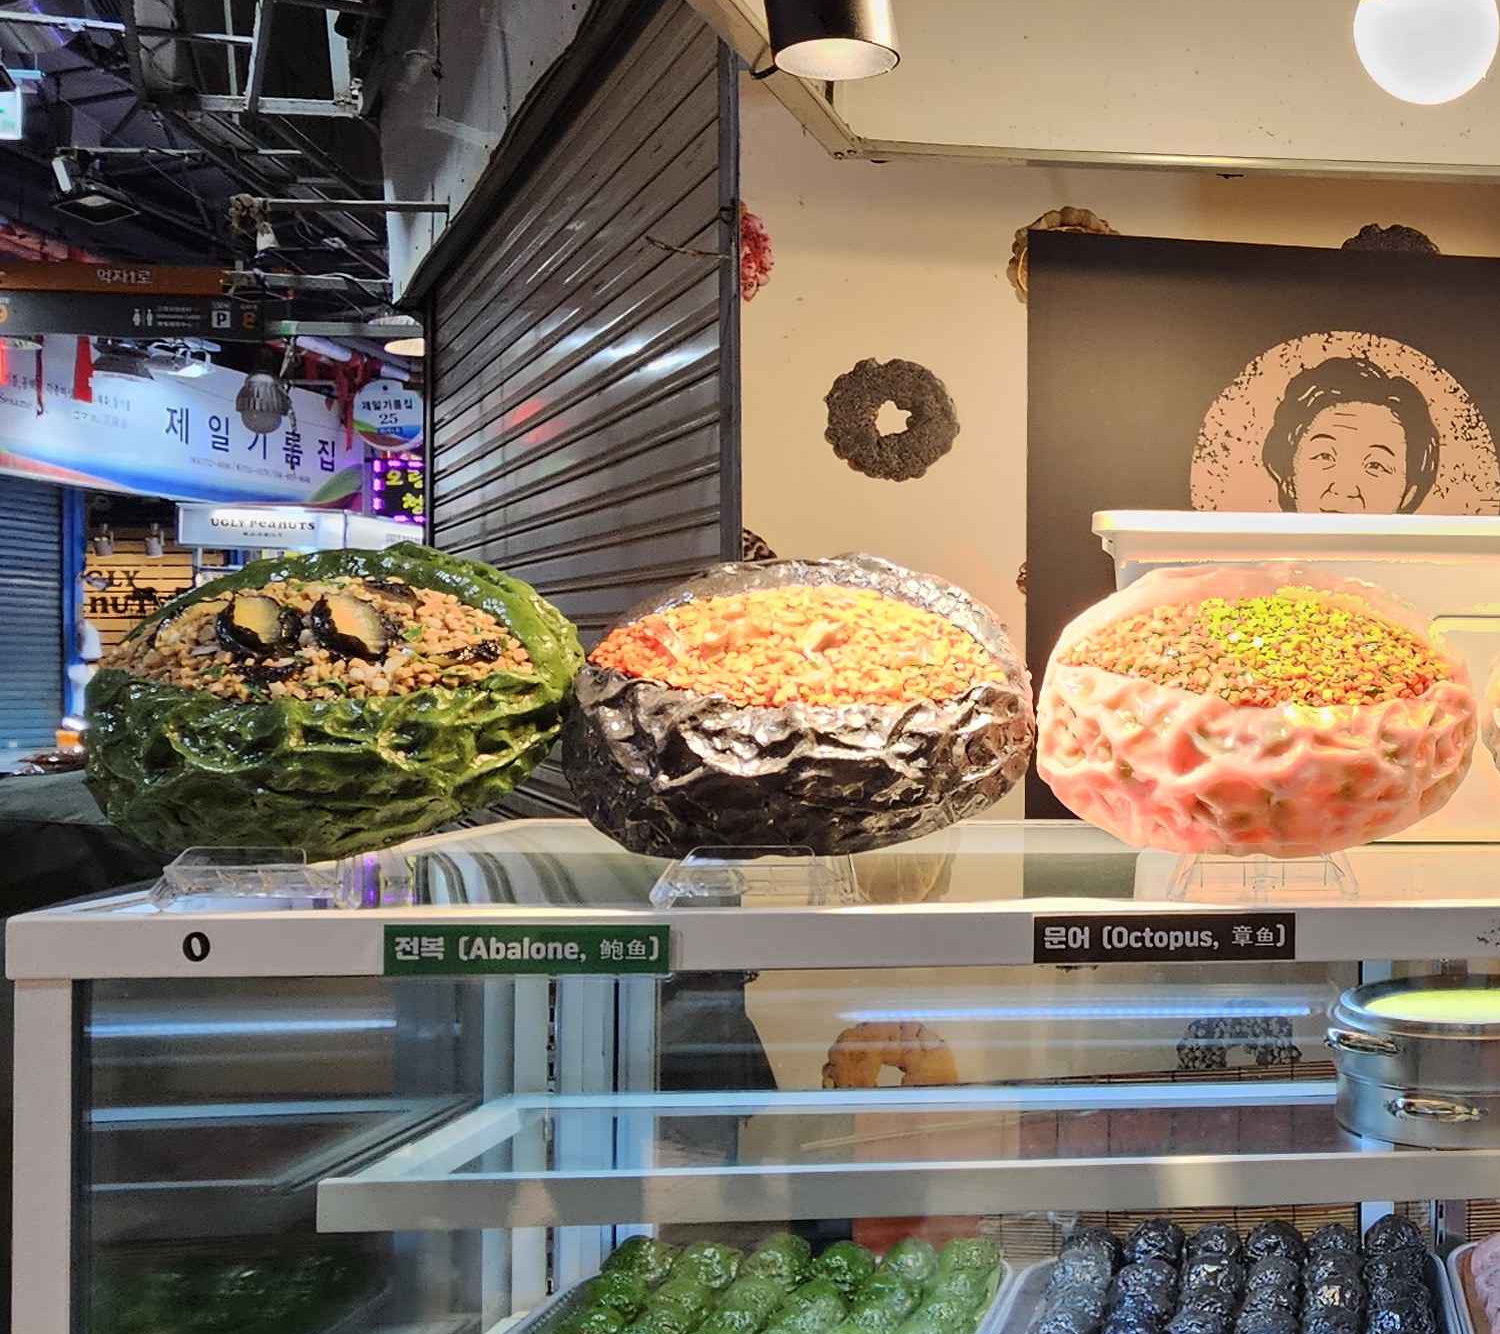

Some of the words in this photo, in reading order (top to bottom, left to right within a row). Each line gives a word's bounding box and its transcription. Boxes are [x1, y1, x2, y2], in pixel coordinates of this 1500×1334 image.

[378, 413, 399, 425] 25
[395, 936, 445, 960] 전복
[1044, 926, 1090, 950] 문어
[1102, 925, 1220, 950] (Octopus,
